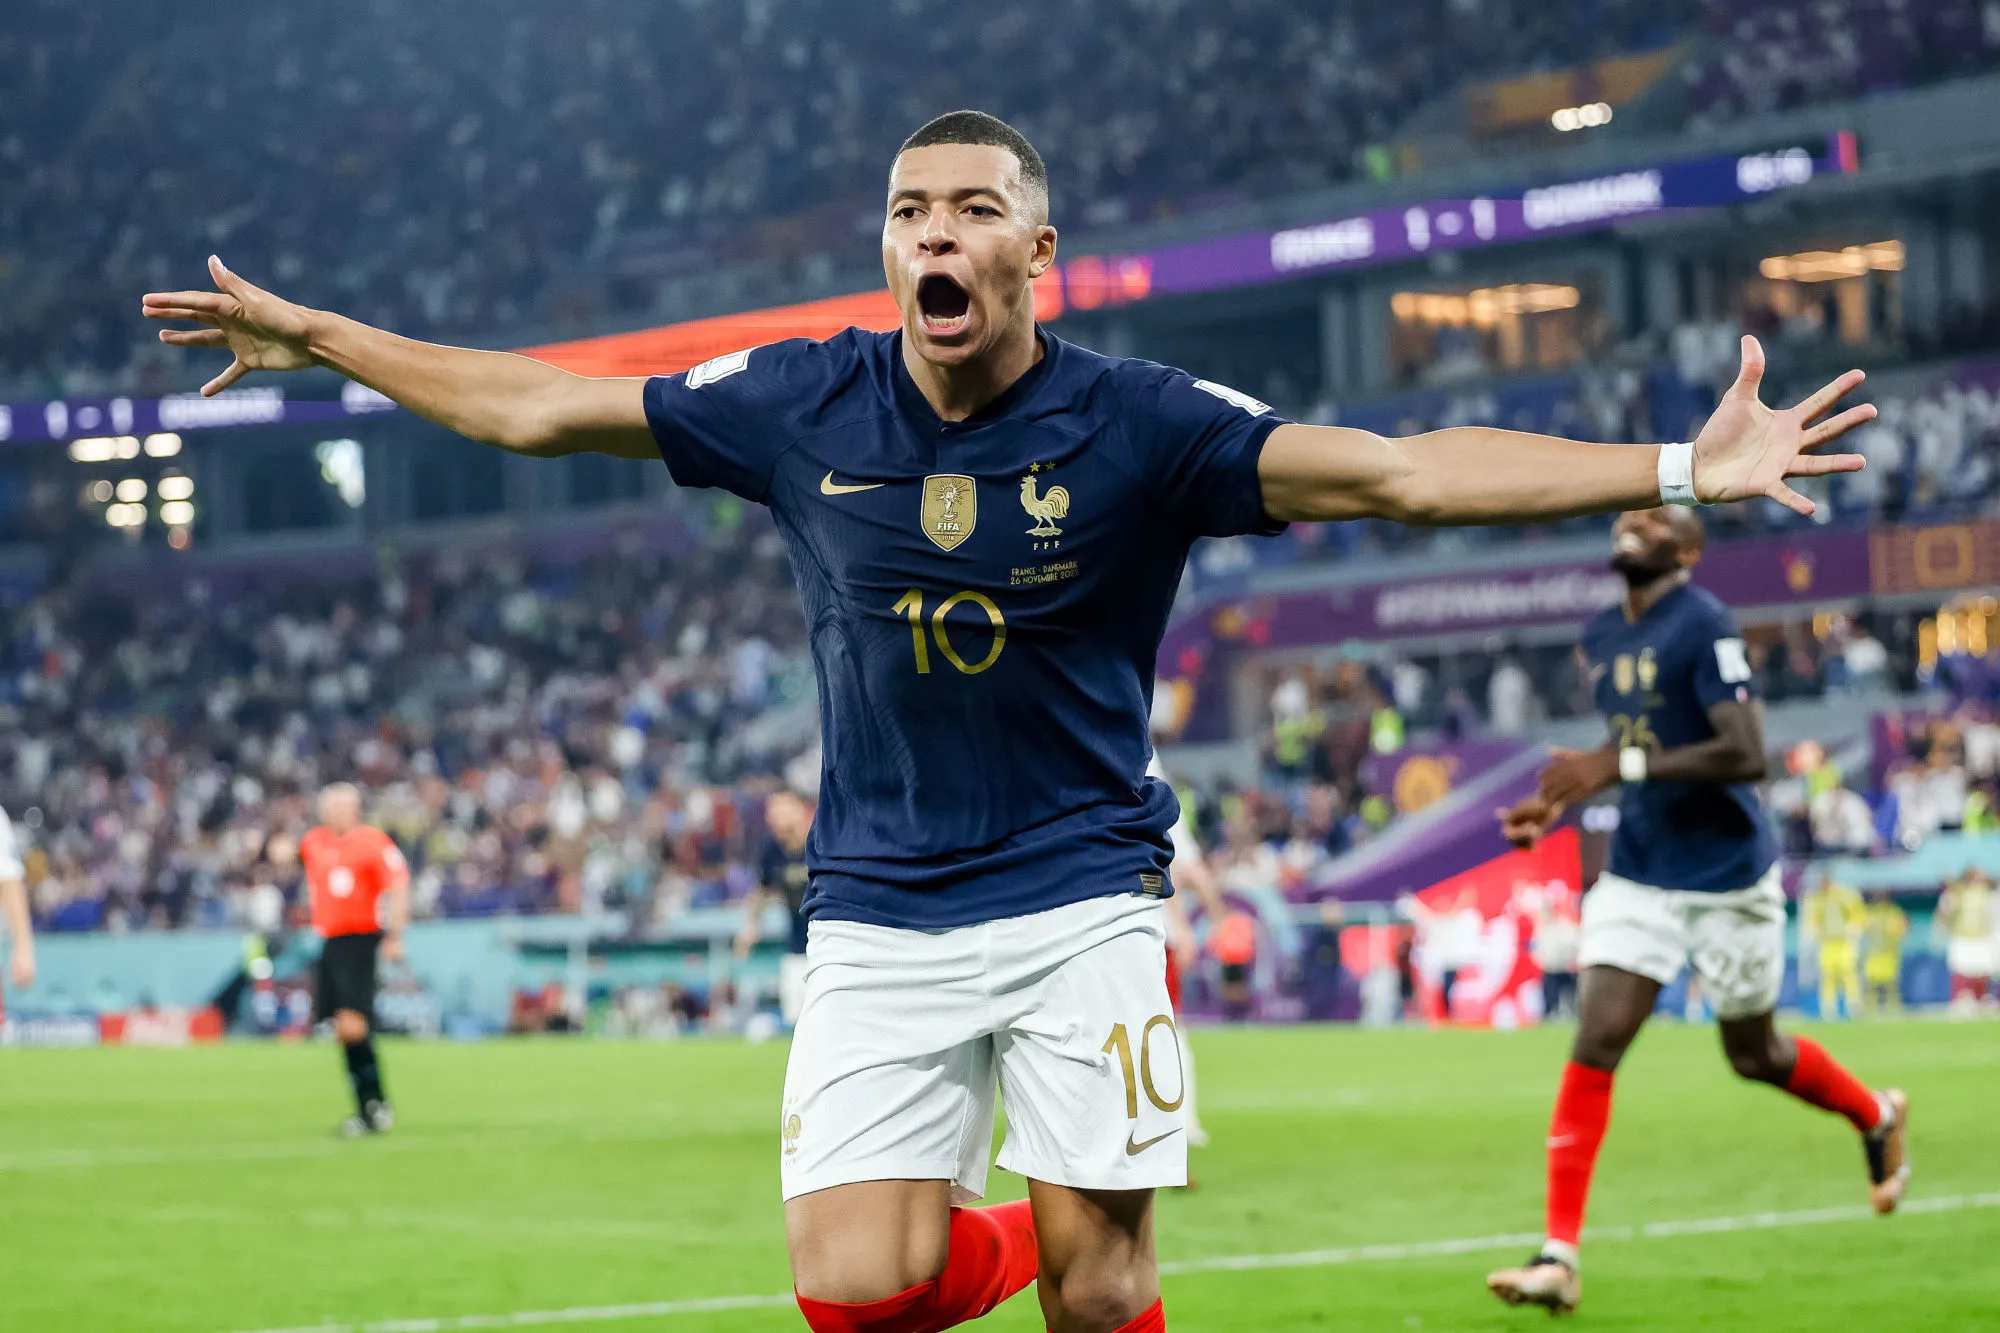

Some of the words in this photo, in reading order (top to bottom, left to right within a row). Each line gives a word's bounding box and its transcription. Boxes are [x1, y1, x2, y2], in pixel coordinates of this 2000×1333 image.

[1404, 207, 1430, 250] 1
[1471, 197, 1496, 241] 1
[937, 522, 960, 531] FIFA
[1010, 576, 1021, 585] 26
[1023, 572, 1058, 584] NOVEMBRE
[1011, 566, 1036, 577] FRANCE
[1043, 561, 1078, 573] DANEMARK
[891, 588, 1007, 675] 10
[1101, 1014, 1184, 1119] 10
